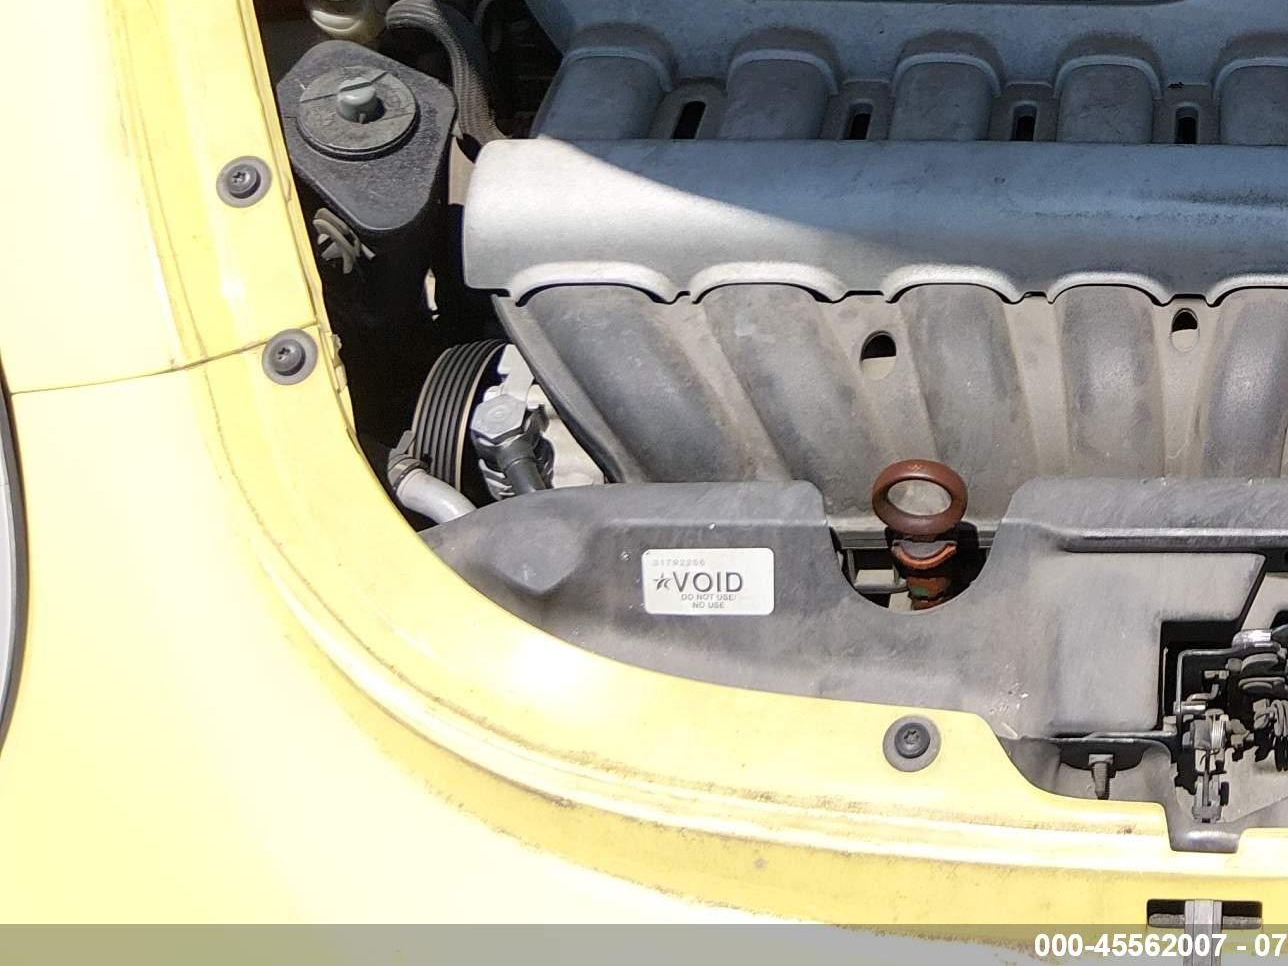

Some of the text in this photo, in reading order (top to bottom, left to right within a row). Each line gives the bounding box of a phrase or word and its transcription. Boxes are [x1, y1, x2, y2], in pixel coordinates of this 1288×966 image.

[672, 571, 744, 593] VOID
[681, 593, 695, 601] DO
[696, 593, 714, 601] NOT
[692, 601, 725, 609] NO USE
